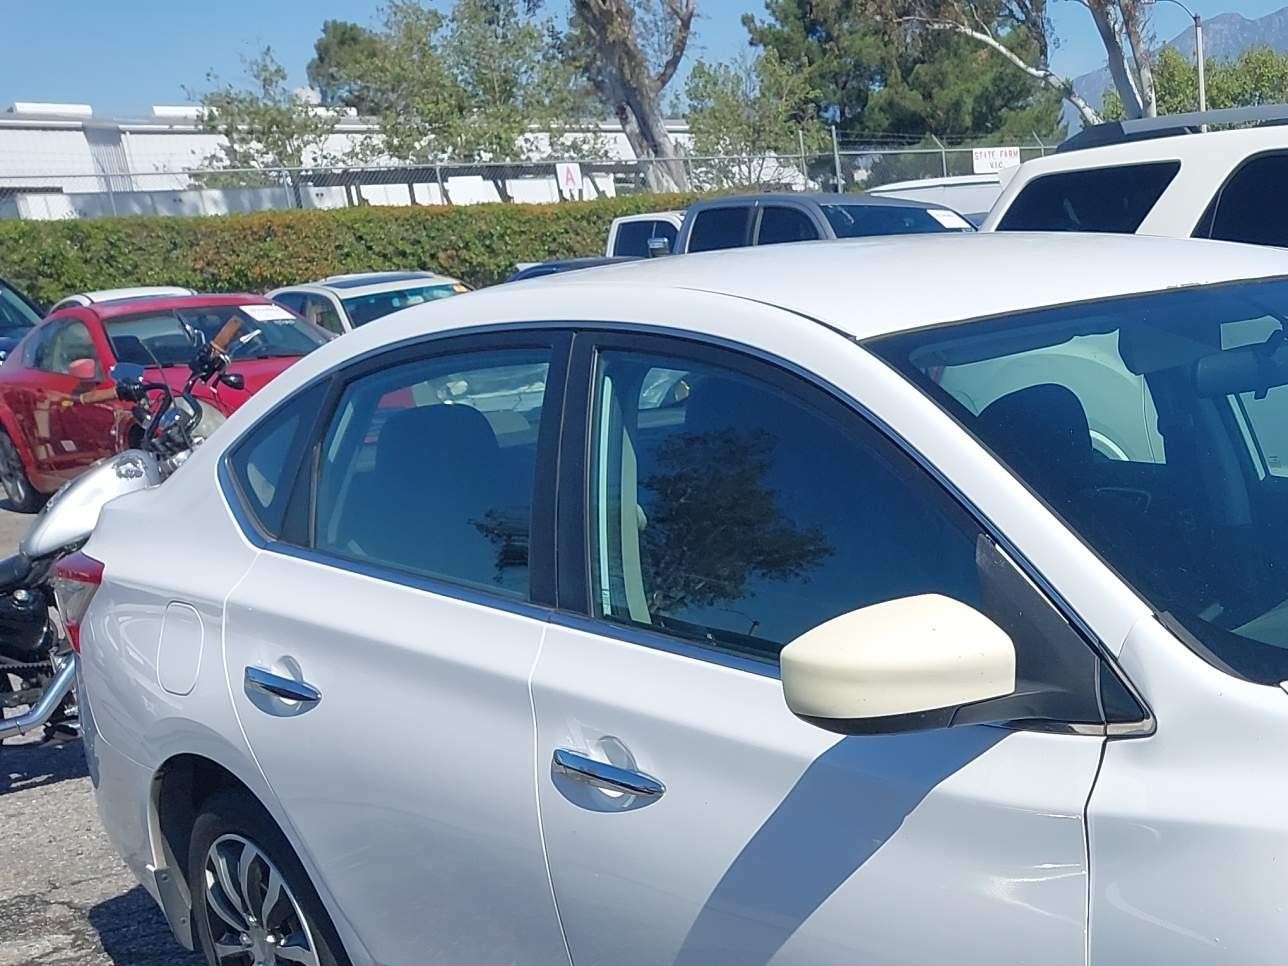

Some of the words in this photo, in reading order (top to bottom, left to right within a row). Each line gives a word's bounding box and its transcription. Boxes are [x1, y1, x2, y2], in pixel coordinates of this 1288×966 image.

[974, 150, 996, 161] STATE
[999, 149, 1019, 159] FARM
[565, 165, 576, 186] A
